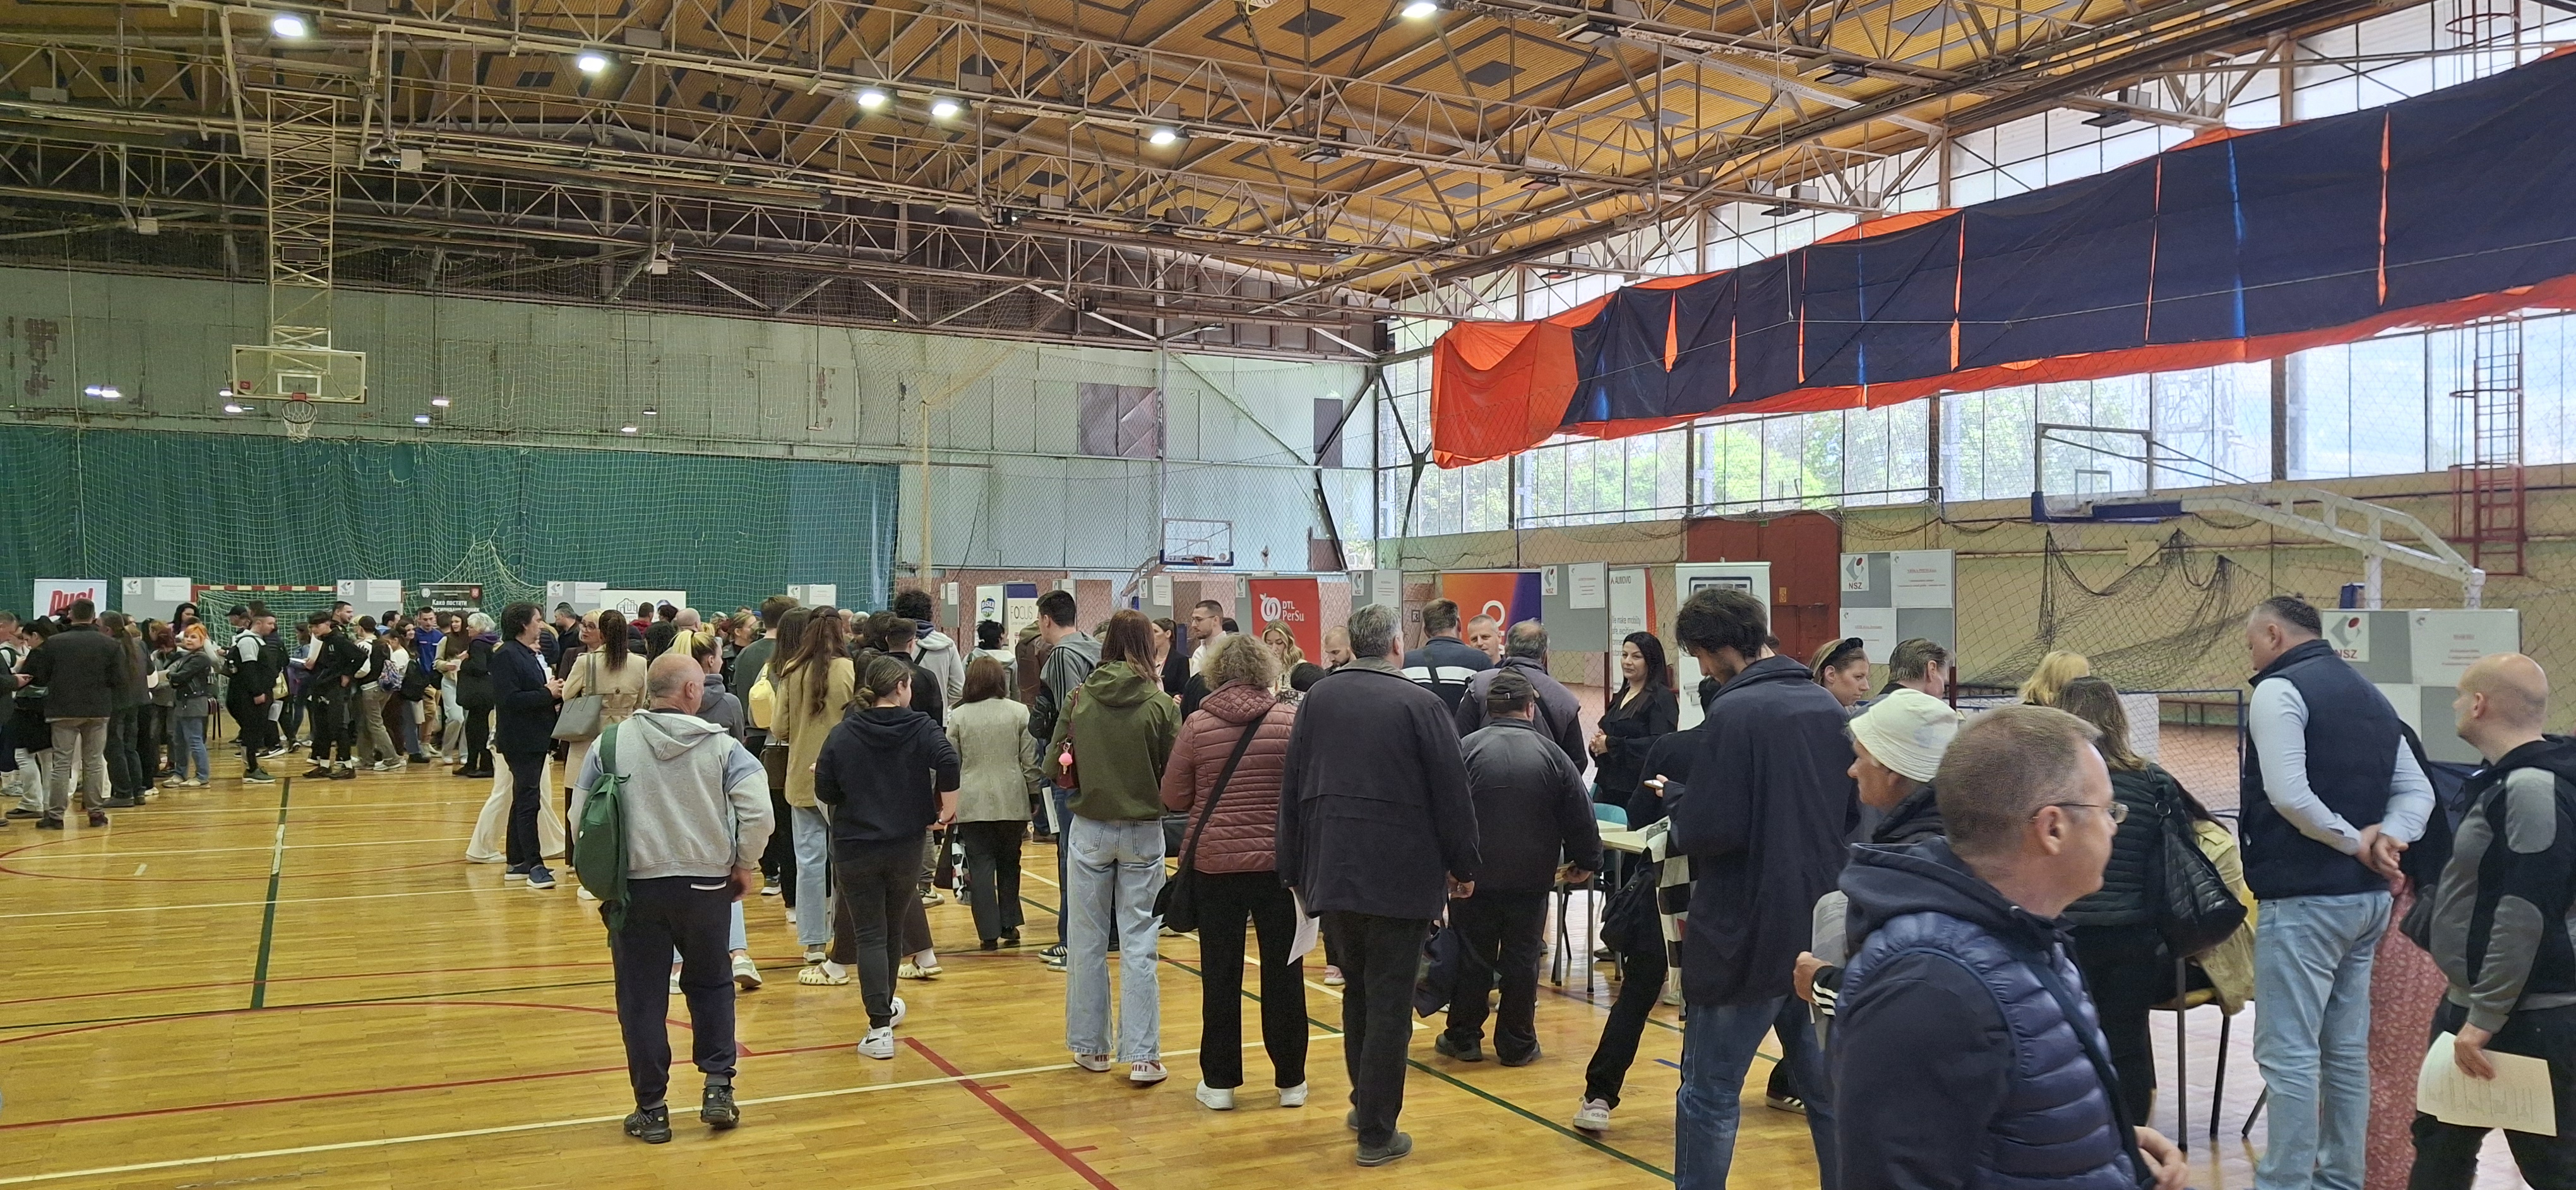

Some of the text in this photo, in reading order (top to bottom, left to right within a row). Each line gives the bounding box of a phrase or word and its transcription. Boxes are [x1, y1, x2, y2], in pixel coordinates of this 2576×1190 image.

[1849, 582, 1863, 590] NSZ
[1282, 601, 1295, 610] DTL
[1010, 606, 1033, 620] FOCUS
[1282, 610, 1304, 622] PerSu
